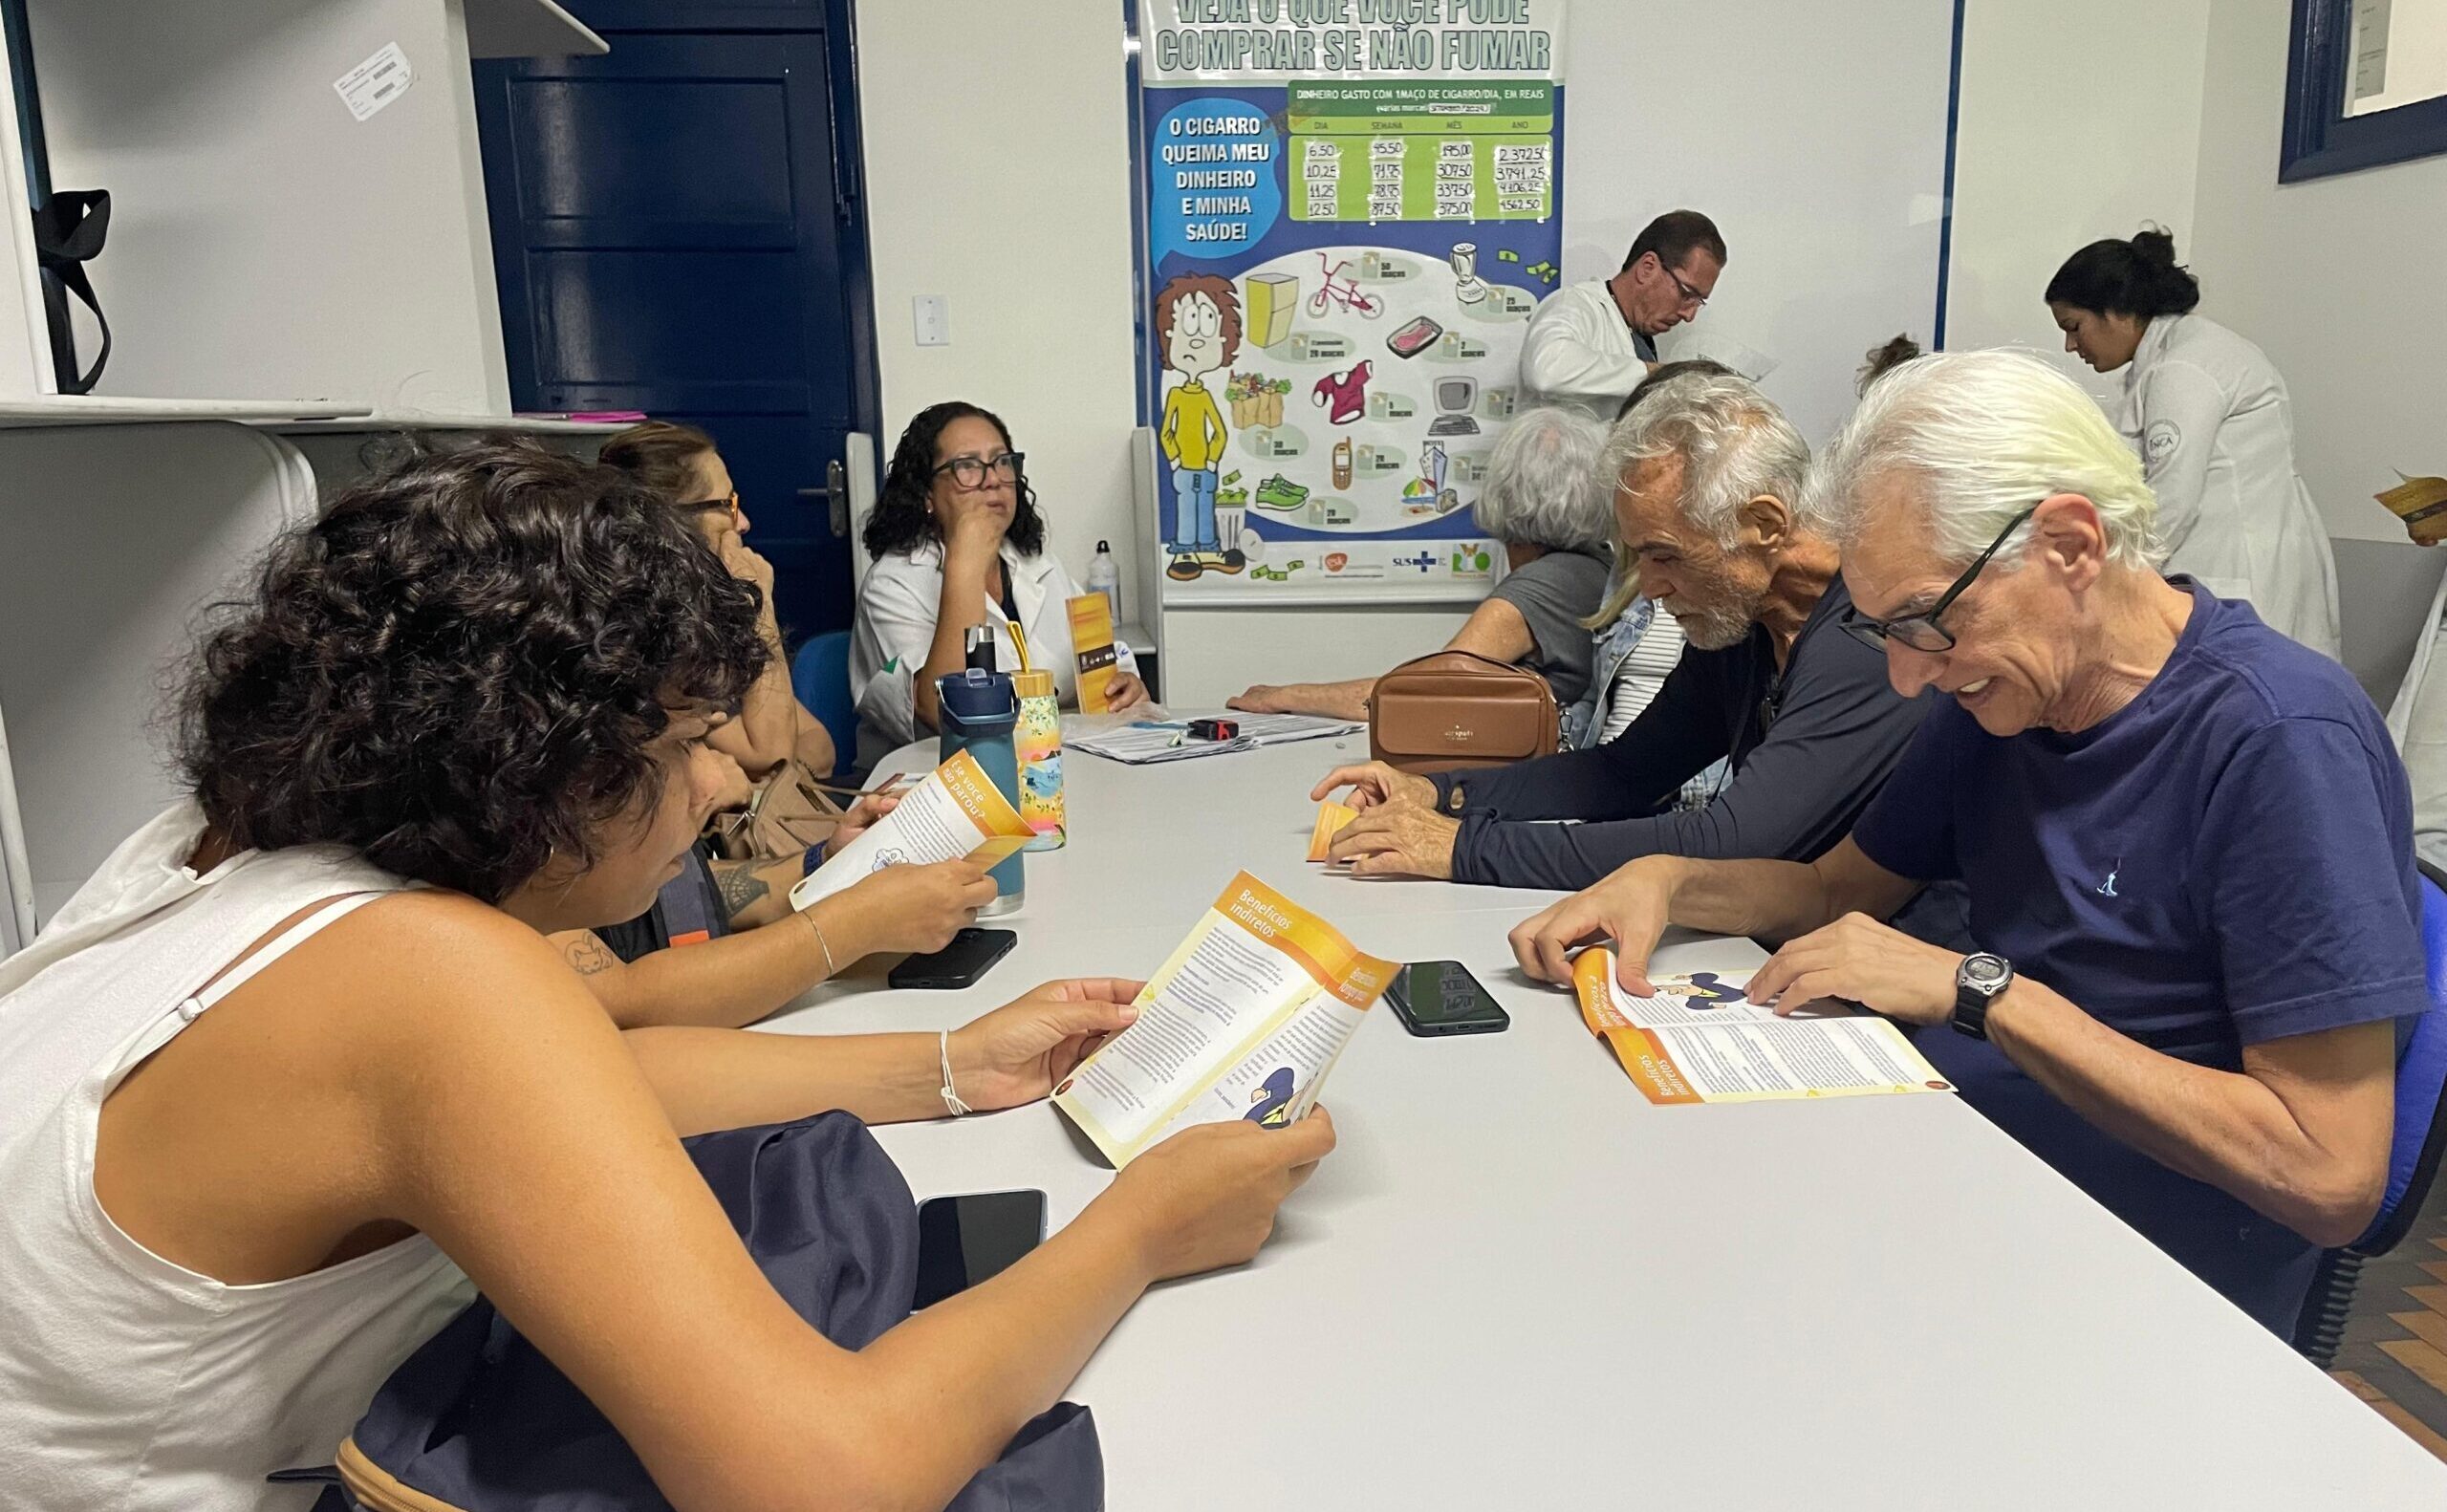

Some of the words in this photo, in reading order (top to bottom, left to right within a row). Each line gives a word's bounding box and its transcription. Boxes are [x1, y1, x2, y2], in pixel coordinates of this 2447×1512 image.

[1178, 0, 1251, 23] VEJA
[1288, 0, 1350, 28] QUE
[1447, 0, 1529, 24] PODE
[1157, 30, 1316, 71] COMPRAR
[1324, 30, 1361, 71] SE
[1369, 22, 1434, 71] NÃO
[1441, 30, 1550, 70] FUMAR
[1296, 90, 1339, 99] DINHEIRO
[1340, 90, 1371, 99] GASTO
[1373, 90, 1393, 98] COM
[1428, 89, 1440, 98] DE
[1504, 89, 1517, 98] EM
[1519, 89, 1545, 98] REAIS
[1169, 118, 1182, 136] O
[1185, 117, 1262, 135] CIGARRO
[1313, 121, 1329, 130] DIA
[1371, 121, 1403, 130] SEMANA
[1511, 120, 1529, 129] ANO
[1162, 144, 1229, 166] QUEIMA
[1232, 143, 1270, 162] MEU
[1177, 169, 1257, 189] DINHEIRO
[1181, 198, 1193, 215] E
[1196, 196, 1252, 214] MINHA
[1185, 219, 1247, 241] SAÚDE!
[1393, 558, 1413, 567] SUS
[964, 776, 986, 803] você
[949, 783, 985, 819] parou?
[1229, 900, 1277, 939] indiretos
[1657, 1059, 1691, 1096] indiretos
